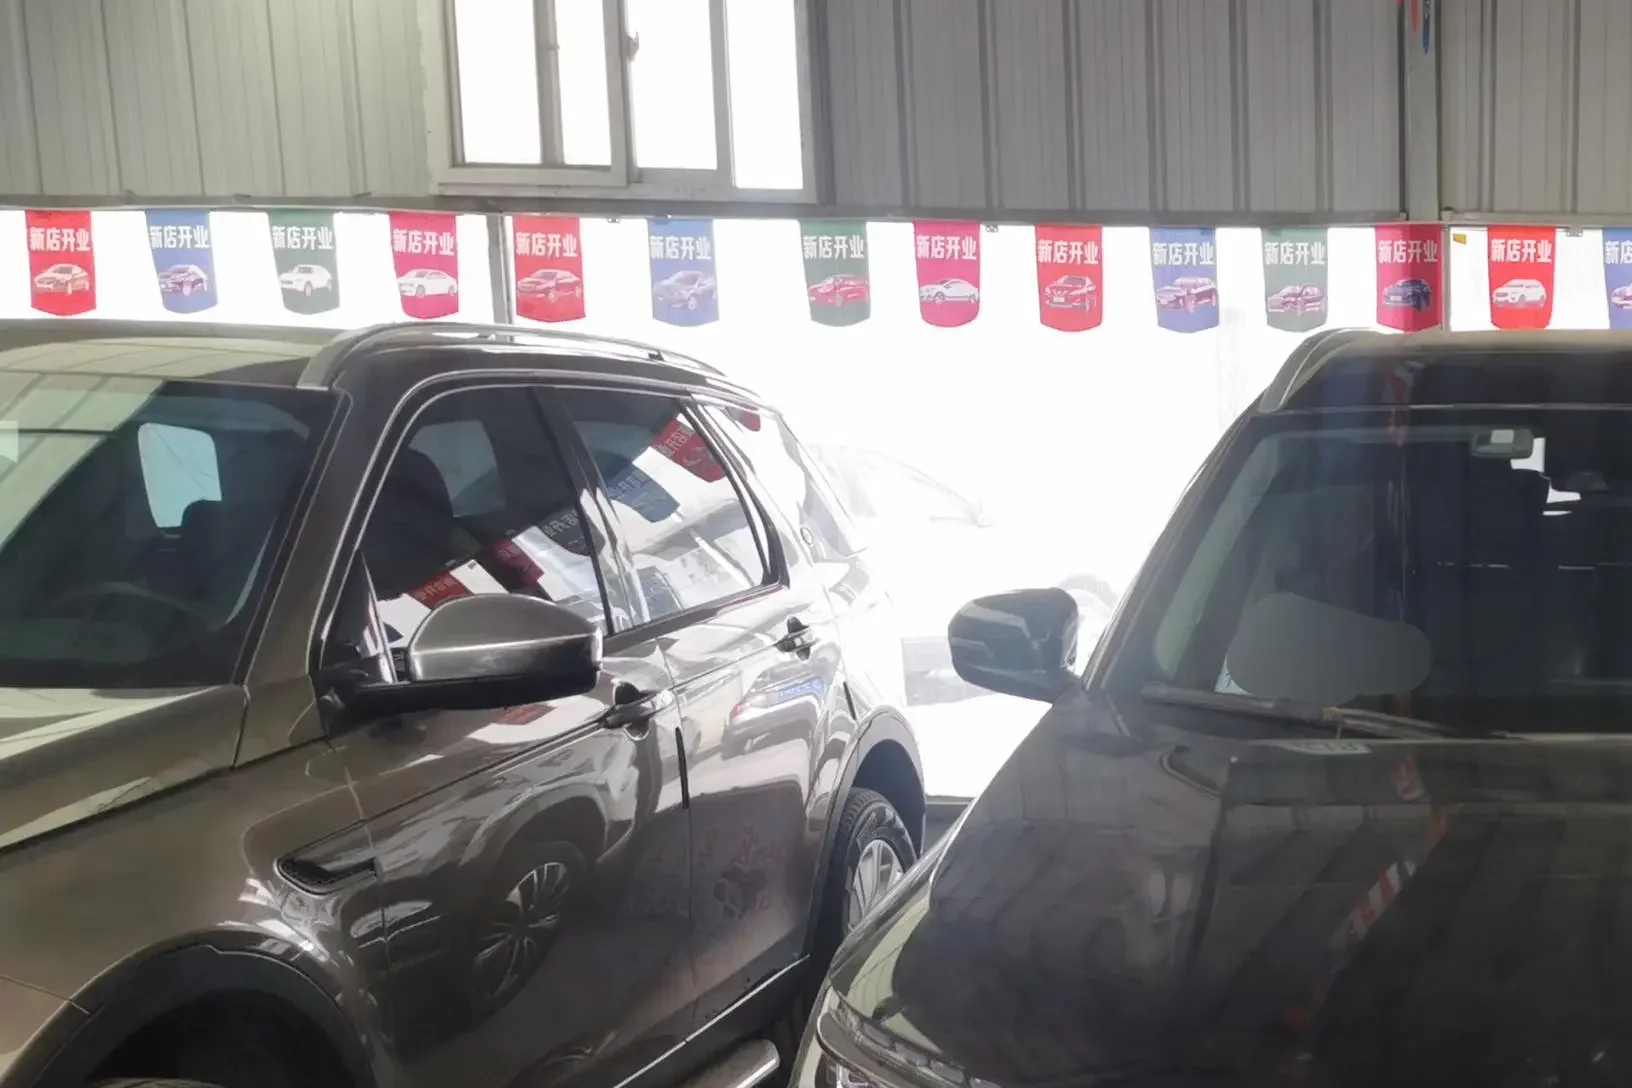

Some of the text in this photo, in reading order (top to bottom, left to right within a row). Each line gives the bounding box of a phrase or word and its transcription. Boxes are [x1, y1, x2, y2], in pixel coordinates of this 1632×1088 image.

[28, 227, 91, 251] 新店开业
[148, 226, 209, 249] 新店开业
[272, 227, 334, 249] 新店开业
[392, 229, 455, 256] 新店开业
[515, 232, 578, 257] 新店开业
[649, 236, 711, 260] 新店开业
[803, 235, 864, 259] 新店开业
[916, 236, 977, 260] 新店开业
[1037, 240, 1099, 264] 新店开业
[1152, 242, 1213, 265] 新店开业
[1264, 242, 1326, 265] 新店开业
[1378, 240, 1438, 264] 新店开业
[1490, 239, 1552, 262] 新店开业
